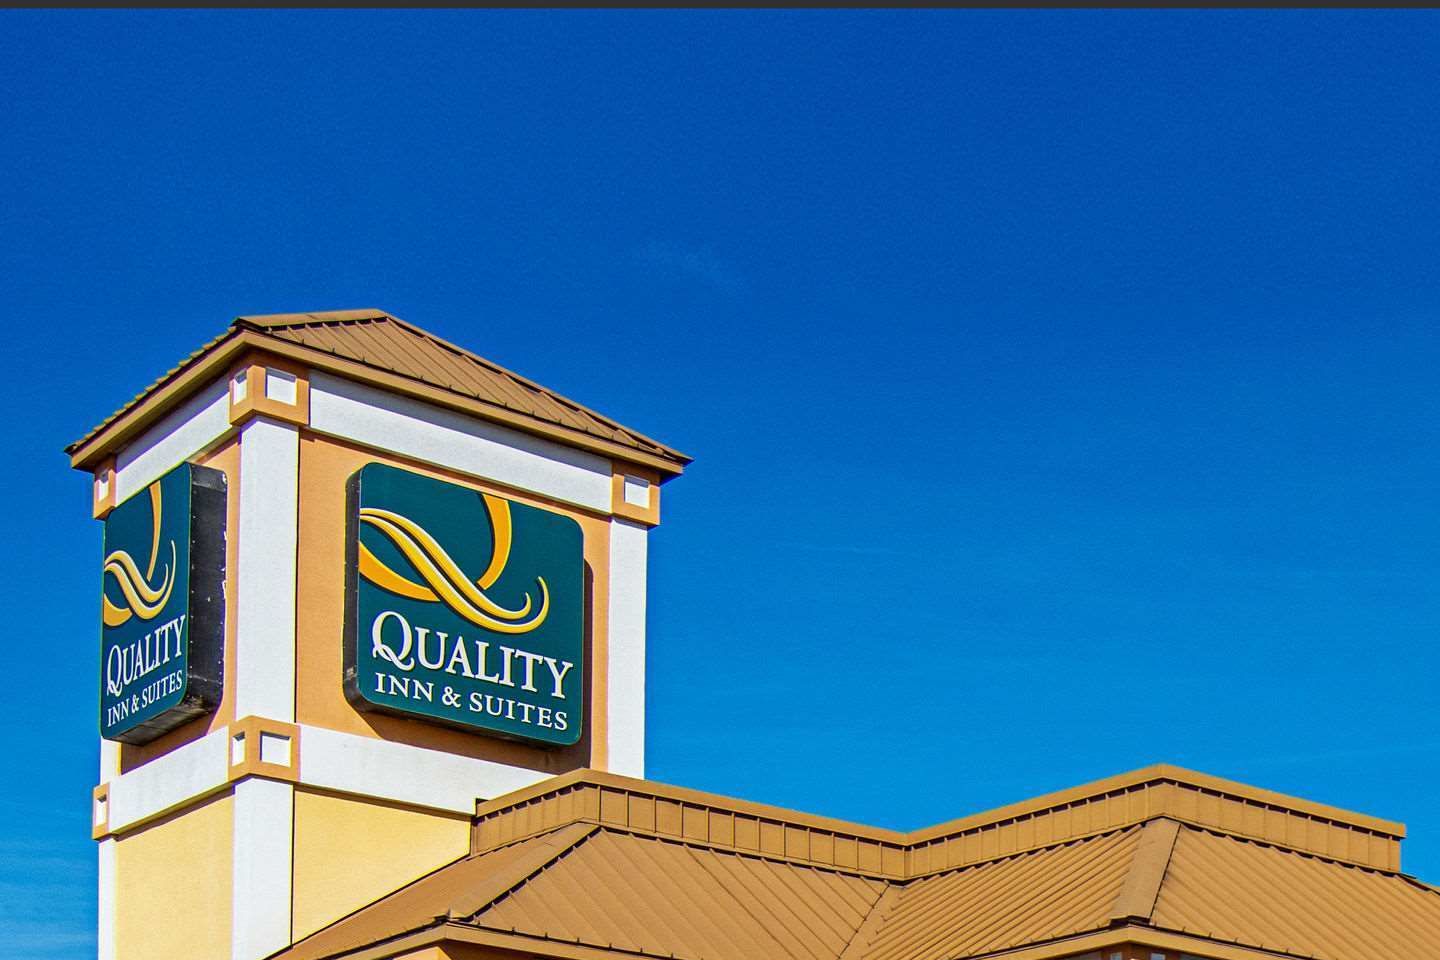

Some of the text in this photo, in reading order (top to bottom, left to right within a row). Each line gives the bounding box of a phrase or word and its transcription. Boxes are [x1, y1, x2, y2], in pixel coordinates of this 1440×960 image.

[107, 614, 185, 697] QUALITY
[372, 611, 573, 699] QUALITY
[107, 669, 183, 727] INN & SUITES
[375, 672, 568, 731] INN & SUITES
